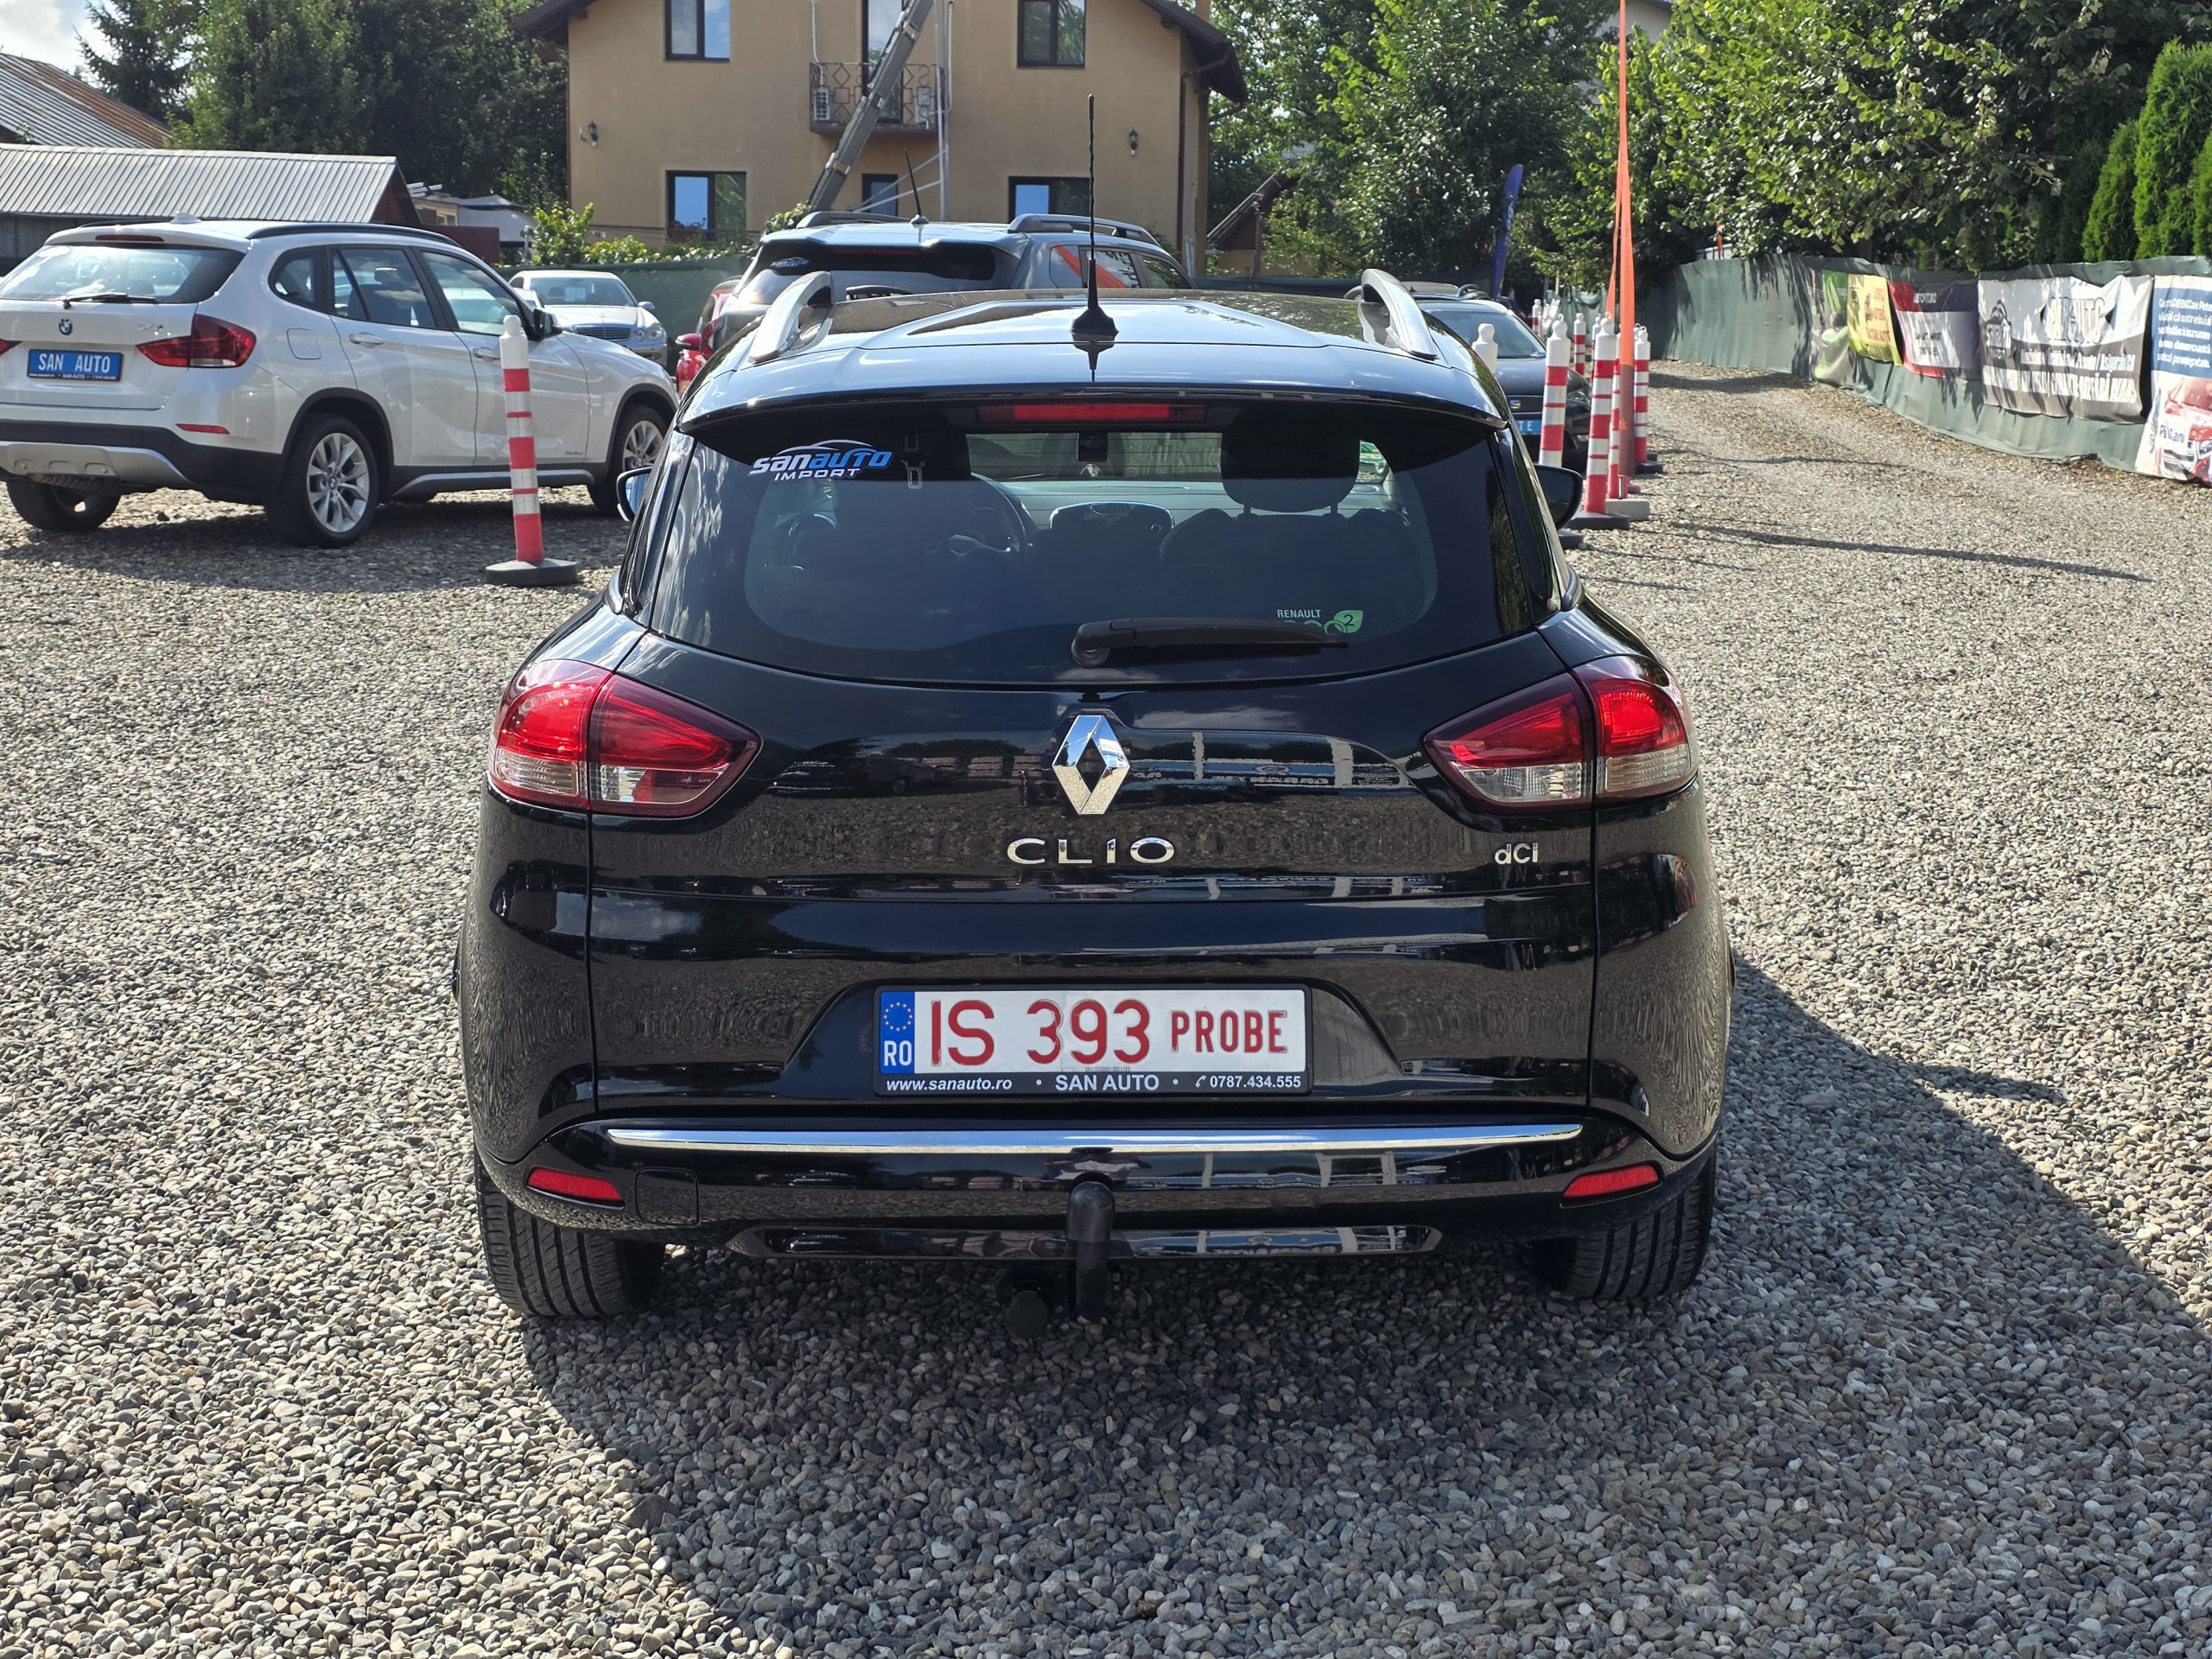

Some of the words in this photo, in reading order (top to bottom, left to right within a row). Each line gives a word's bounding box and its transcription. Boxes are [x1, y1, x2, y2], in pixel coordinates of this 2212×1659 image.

[38, 353, 64, 372] SAN
[74, 354, 111, 373] AUTO
[774, 467, 861, 481] IMPORT
[1277, 609, 1321, 619] RENAULT
[1007, 836, 1175, 865] CLIO
[1494, 842, 1538, 865] dCi
[931, 999, 995, 1066] IS
[1027, 998, 1151, 1065] 393
[1171, 1009, 1288, 1054] PROBE
[883, 1039, 912, 1066] RO
[887, 1077, 1013, 1091] www.sanauto.ro
[1055, 1074, 1097, 1091] SAN
[1102, 1073, 1160, 1091] AUTO
[1210, 1075, 1301, 1089] 0787.434.555
